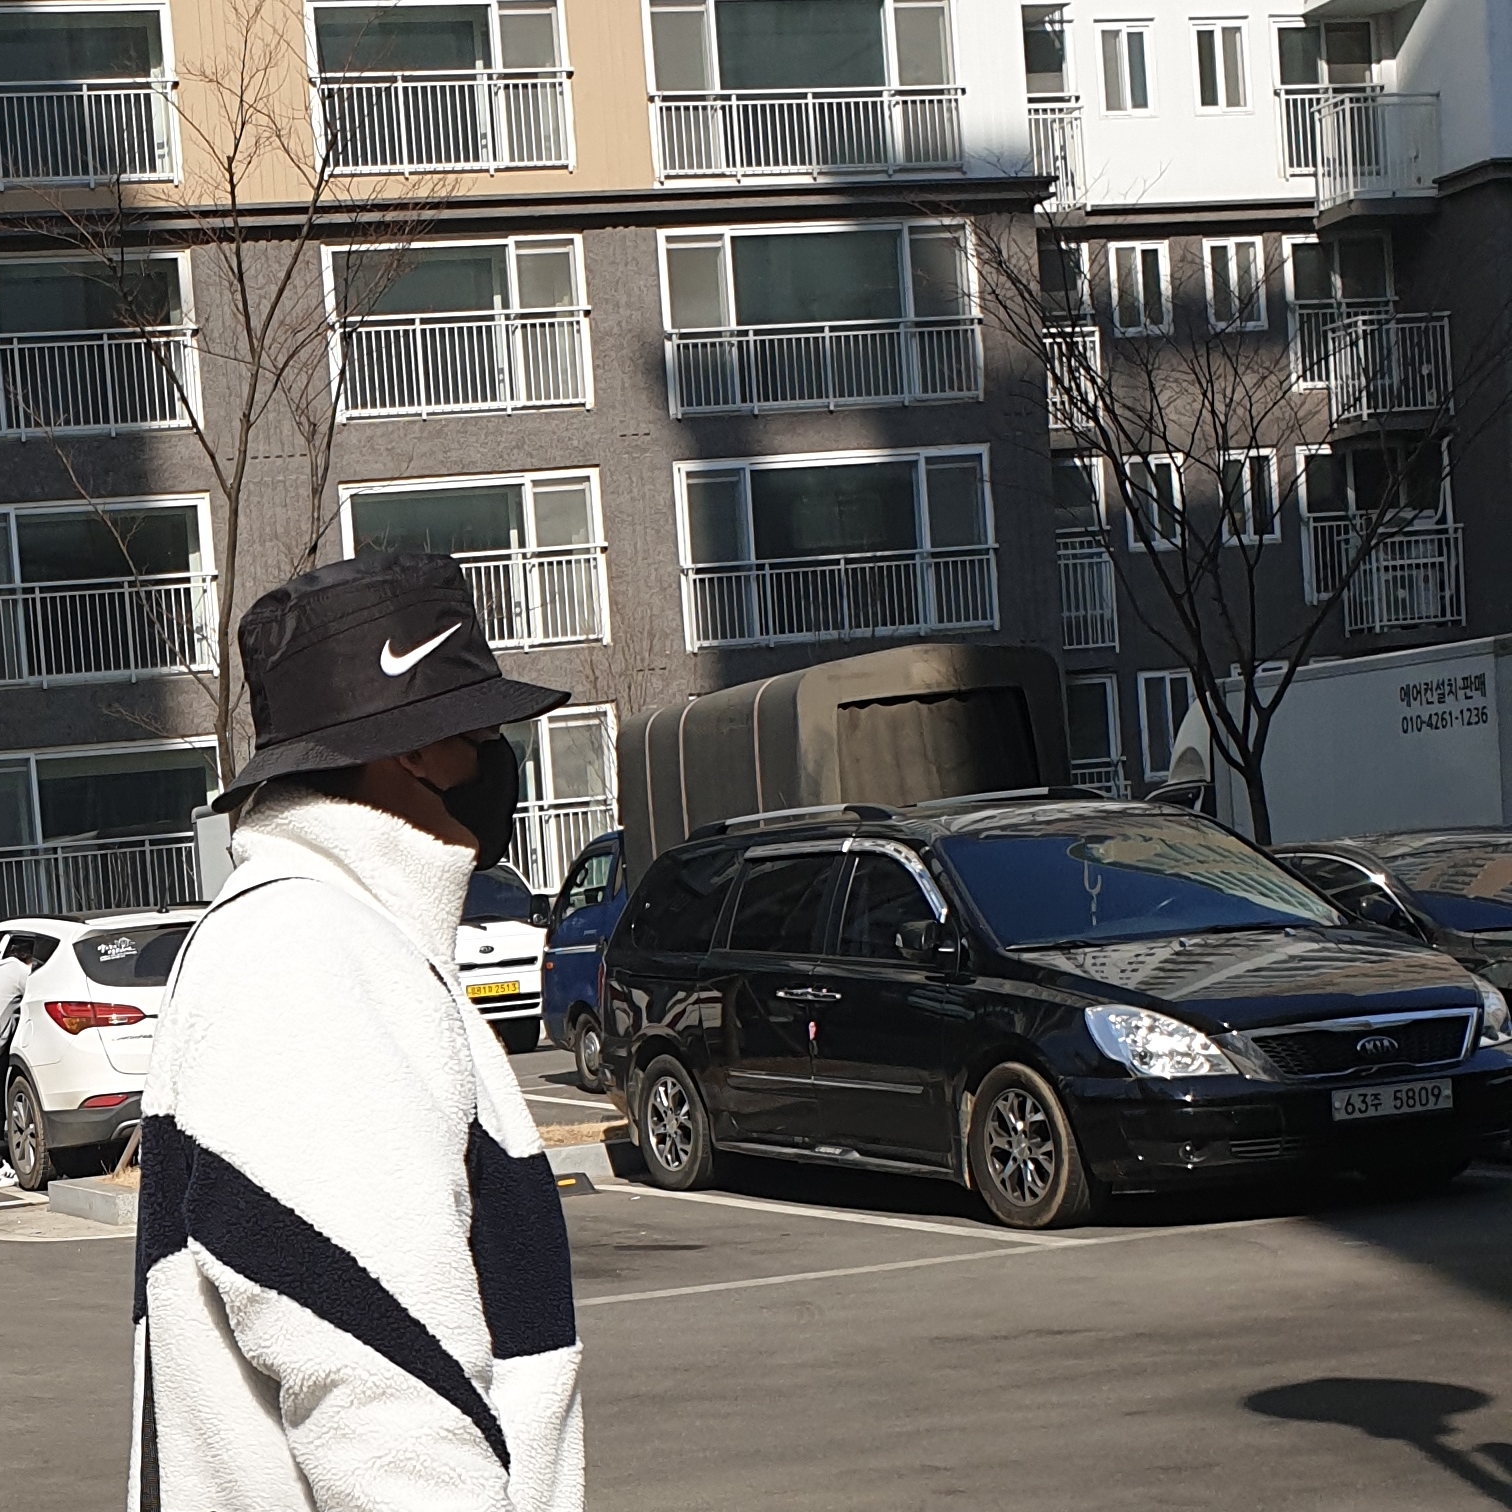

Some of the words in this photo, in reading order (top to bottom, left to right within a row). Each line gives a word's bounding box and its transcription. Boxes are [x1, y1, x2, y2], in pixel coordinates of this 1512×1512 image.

[1401, 705, 1488, 734] 010-4261-1236
[494, 982, 517, 994] 2513
[1344, 1092, 1382, 1116] 63주
[1393, 1084, 1442, 1110] 5809
